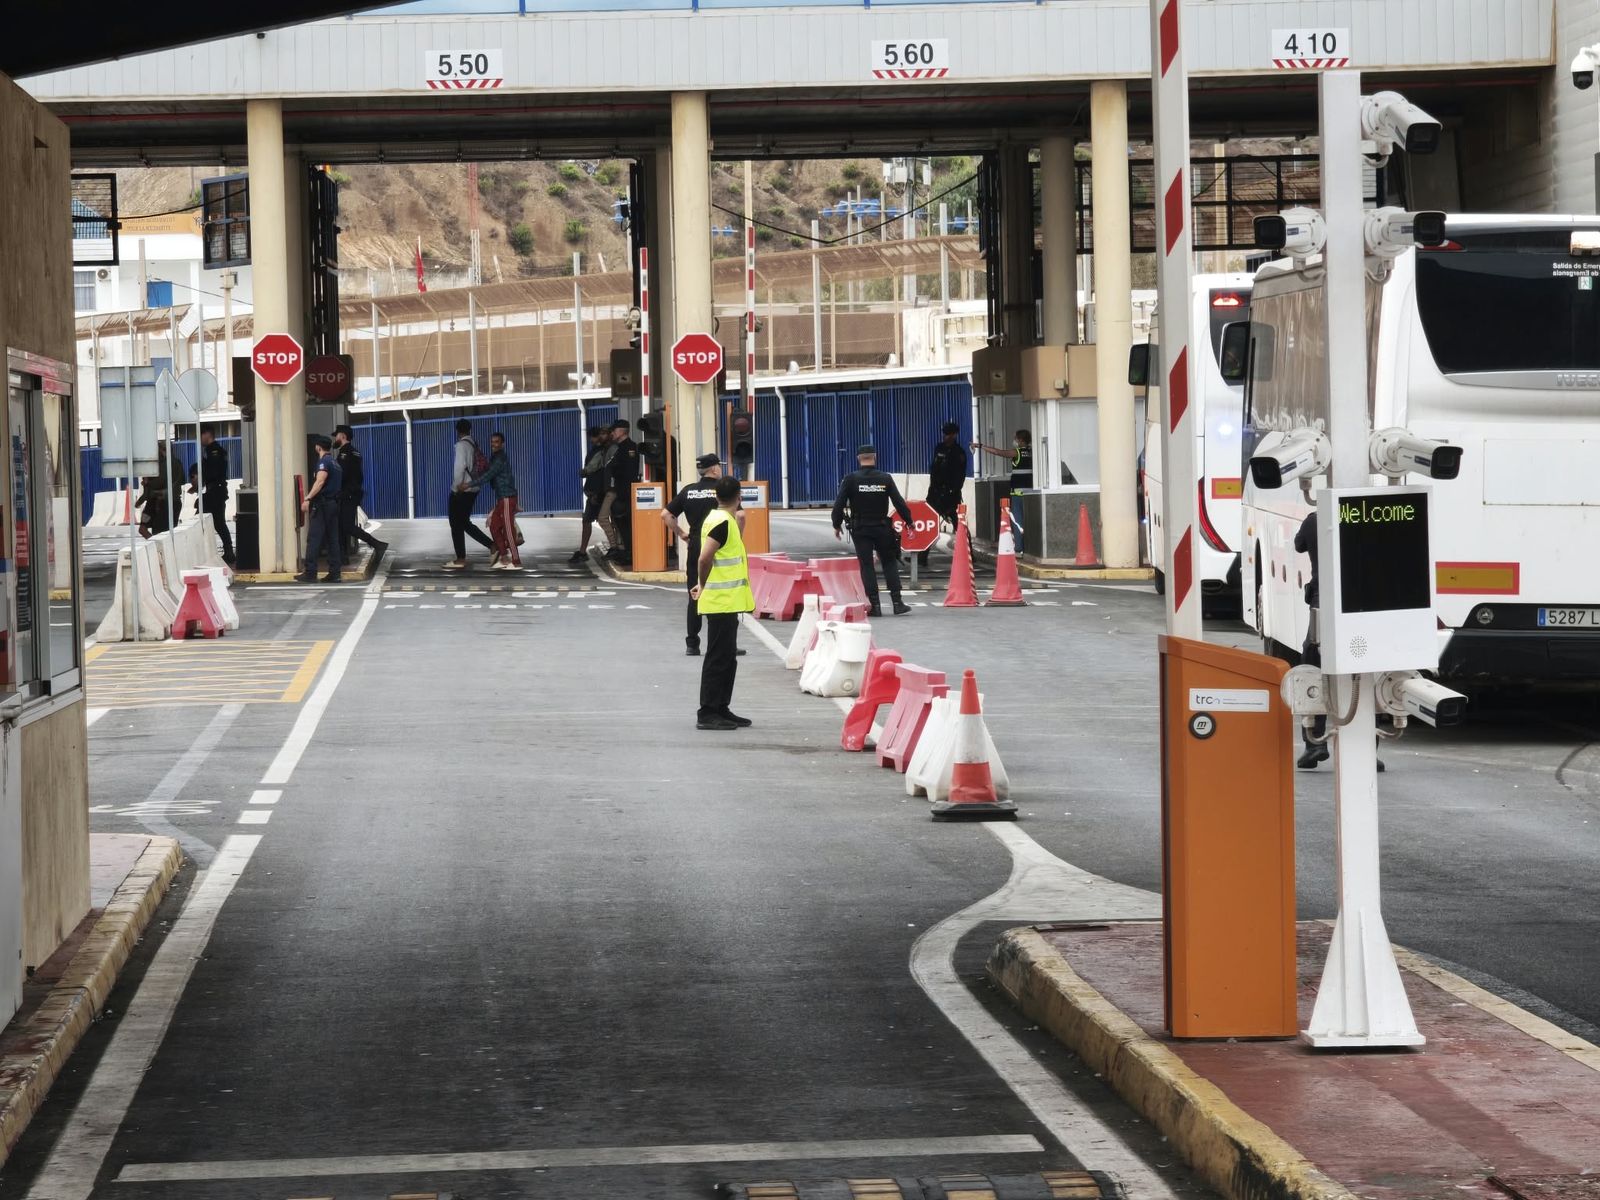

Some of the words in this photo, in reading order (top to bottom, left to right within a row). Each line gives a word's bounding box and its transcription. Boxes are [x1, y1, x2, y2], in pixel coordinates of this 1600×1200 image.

[1284, 32, 1337, 57] 4,10
[884, 42, 934, 68] 5,60
[438, 53, 489, 78] 5,50
[256, 352, 298, 365] STOP
[676, 351, 718, 365] STOP
[308, 372, 346, 383] STOP
[1556, 373, 1600, 387] IVEC
[1338, 500, 1415, 524] Welcome
[893, 520, 936, 533] SOP
[1549, 610, 1586, 625] 5287
